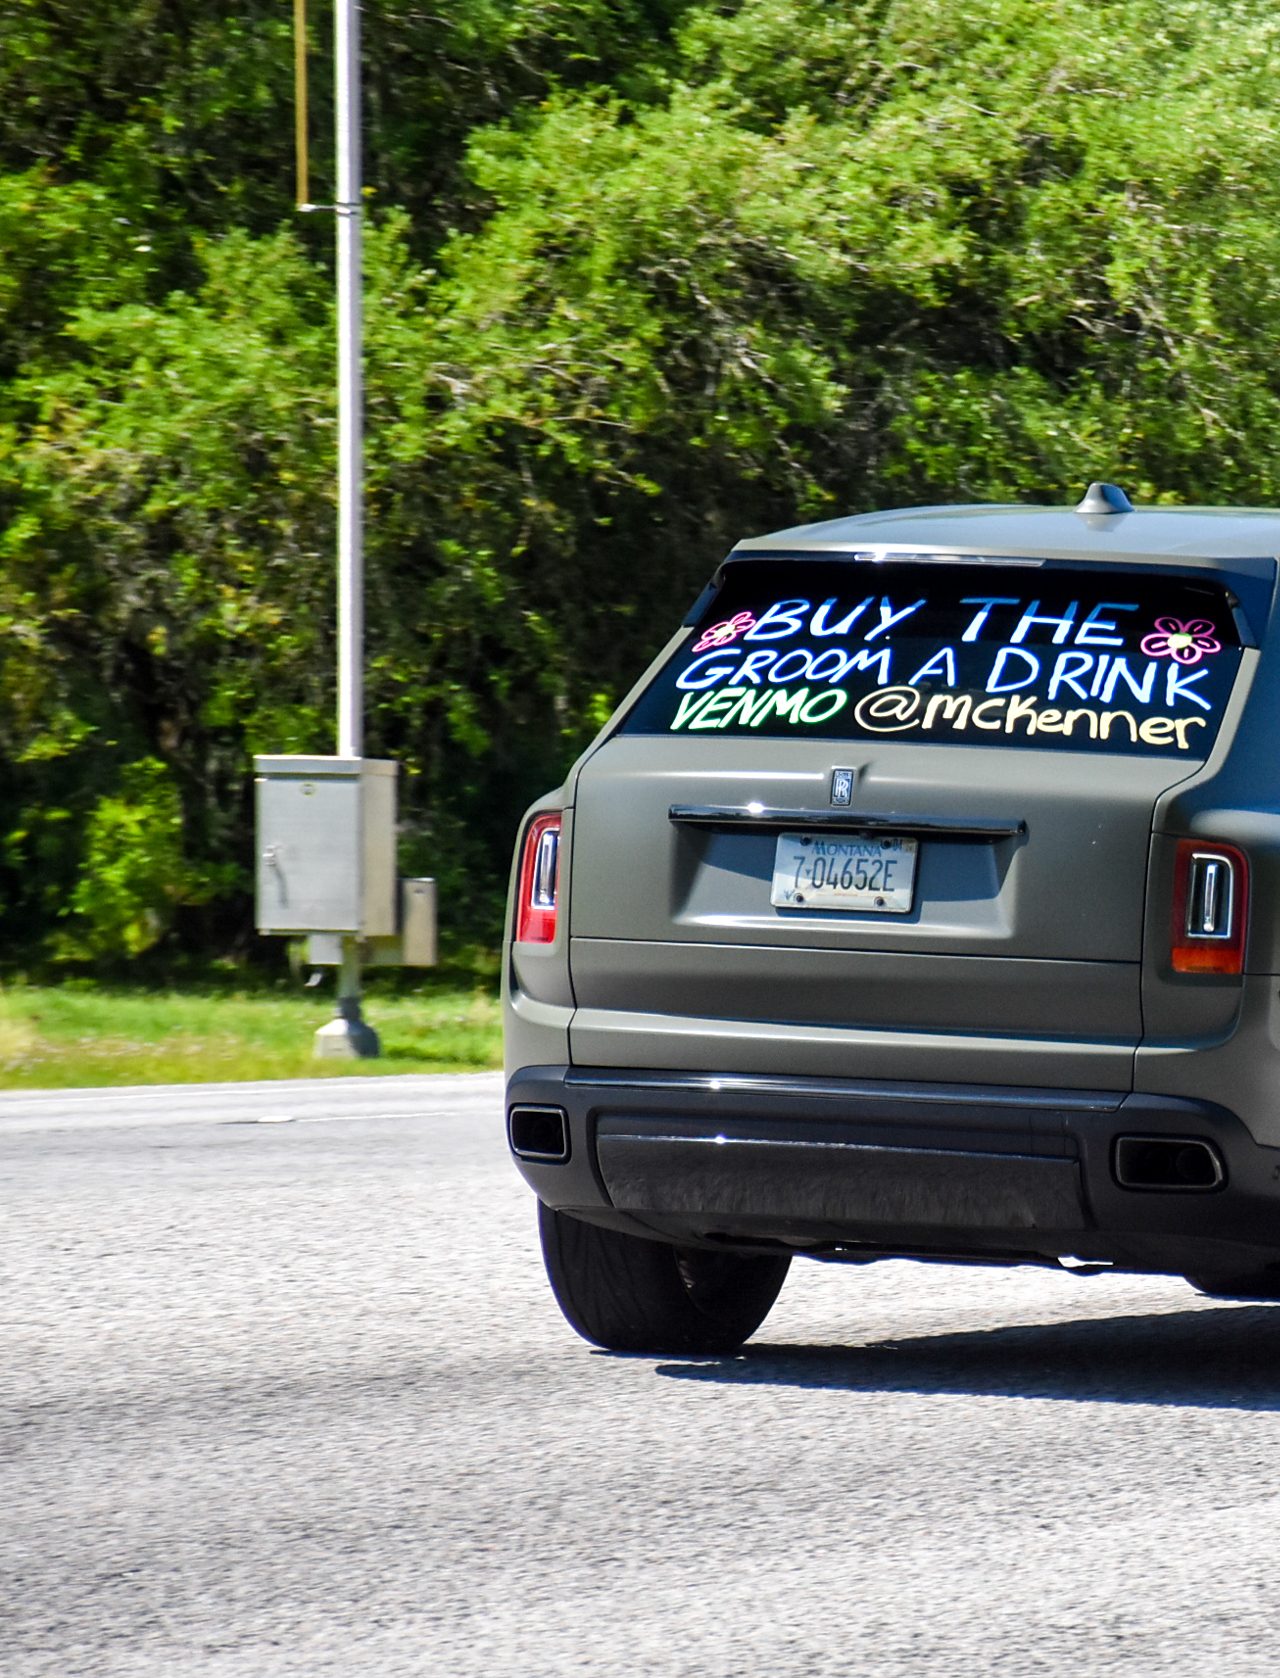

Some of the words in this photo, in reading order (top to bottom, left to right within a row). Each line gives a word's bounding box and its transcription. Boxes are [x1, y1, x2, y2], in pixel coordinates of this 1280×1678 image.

[743, 597, 926, 640] BUY
[960, 597, 1139, 646] THE
[676, 648, 892, 689] GROOM
[909, 647, 956, 685] A
[985, 647, 1211, 710] DRINK
[670, 687, 848, 730] VENMO
